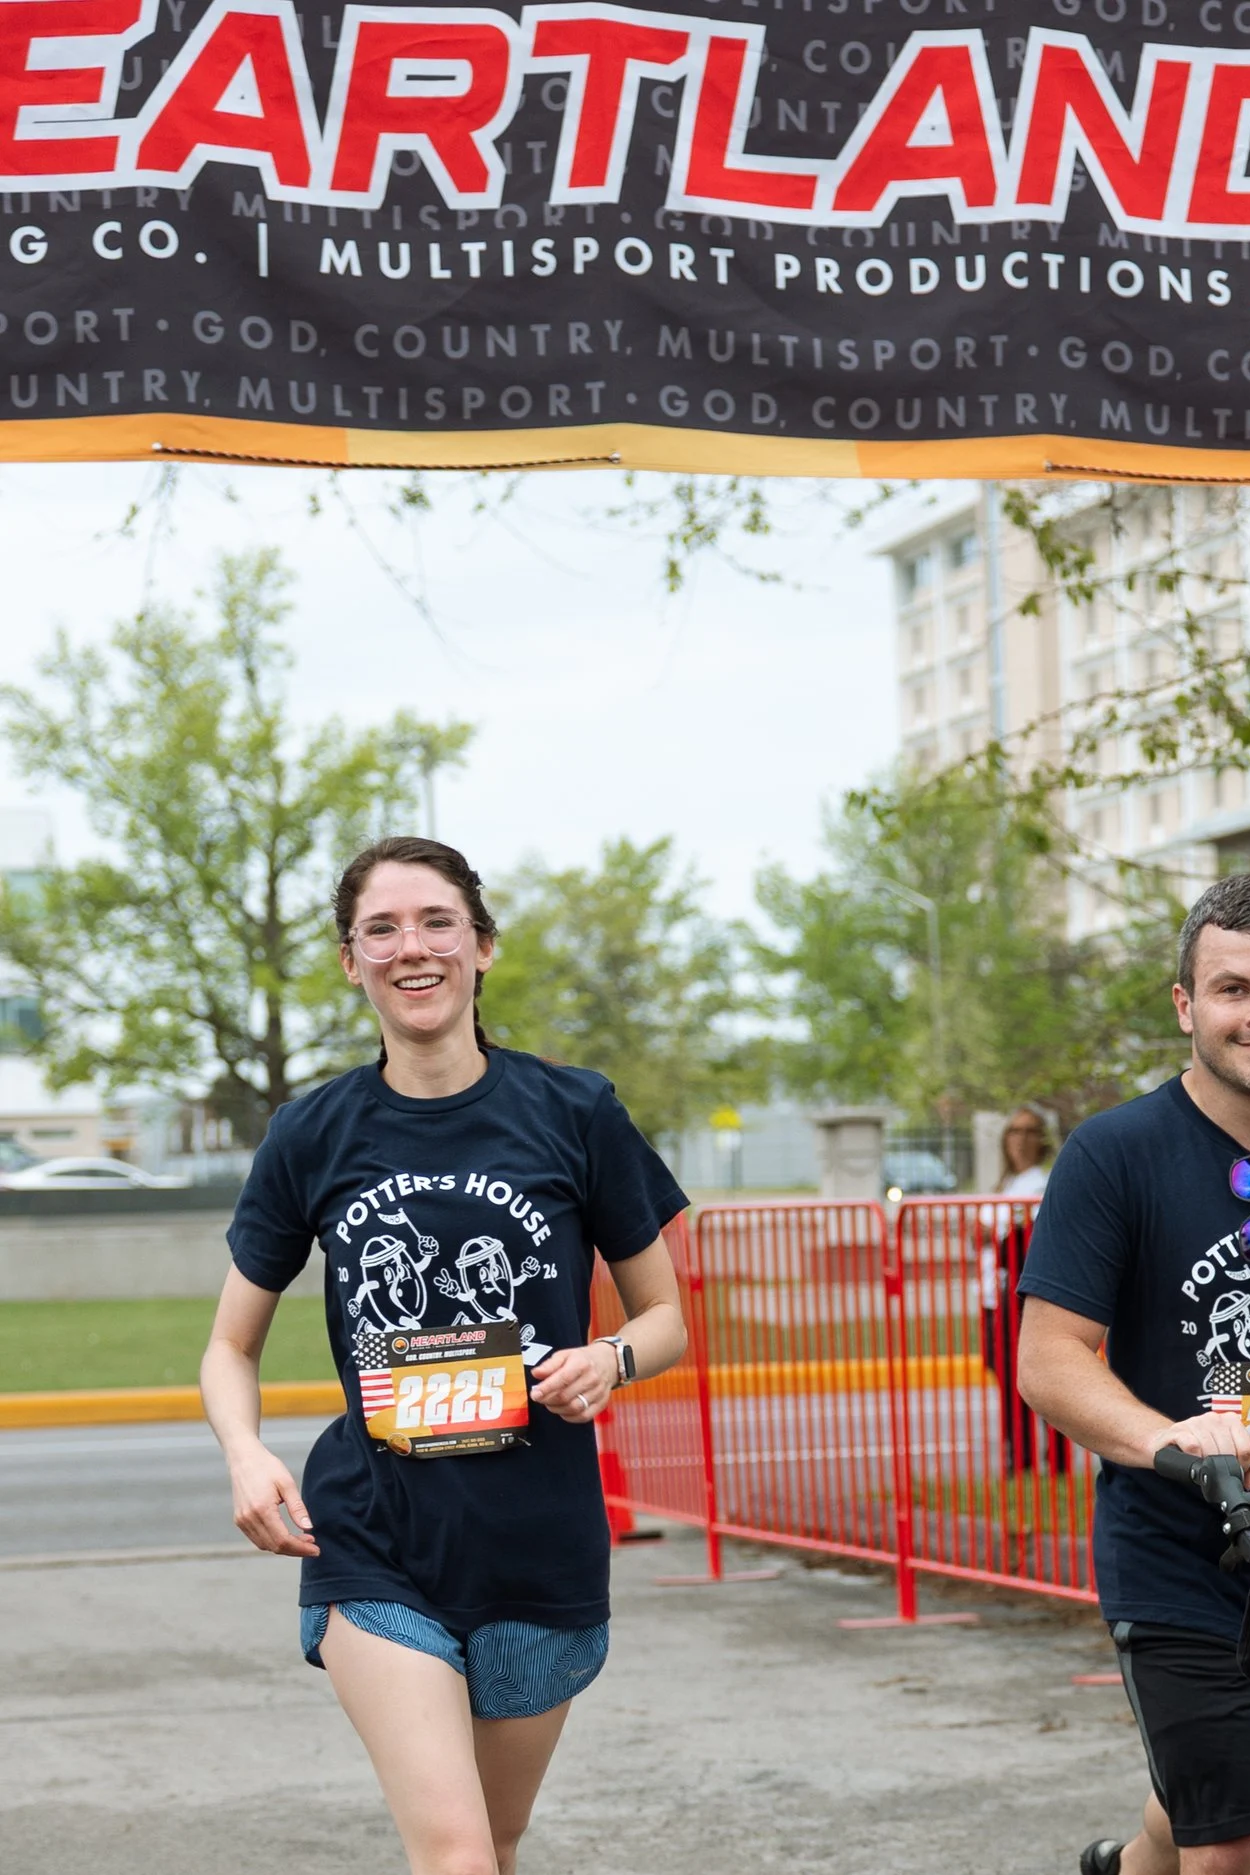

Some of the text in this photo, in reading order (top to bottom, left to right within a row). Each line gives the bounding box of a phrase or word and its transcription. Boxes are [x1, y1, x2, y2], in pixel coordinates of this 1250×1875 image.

[91, 218, 208, 265] CO.
[319, 236, 735, 284] MULTISPORT
[773, 251, 1233, 306] PRODUCTIONS
[193, 309, 327, 358] GOD,
[356, 320, 632, 358] COUNTRY,
[658, 326, 1007, 370] MULTISPORT
[1059, 337, 1181, 380] GOD,
[237, 375, 606, 421] MULTISPORT
[658, 384, 786, 429] GOD,
[813, 393, 1076, 429] COUNTRY,
[336, 1173, 551, 1247] POTTER'S HOUSE
[337, 1263, 558, 1283] 20 26
[410, 1330, 487, 1348] HEARTLAND
[1181, 1320, 1198, 1335] 20
[396, 1368, 506, 1429] 2225
